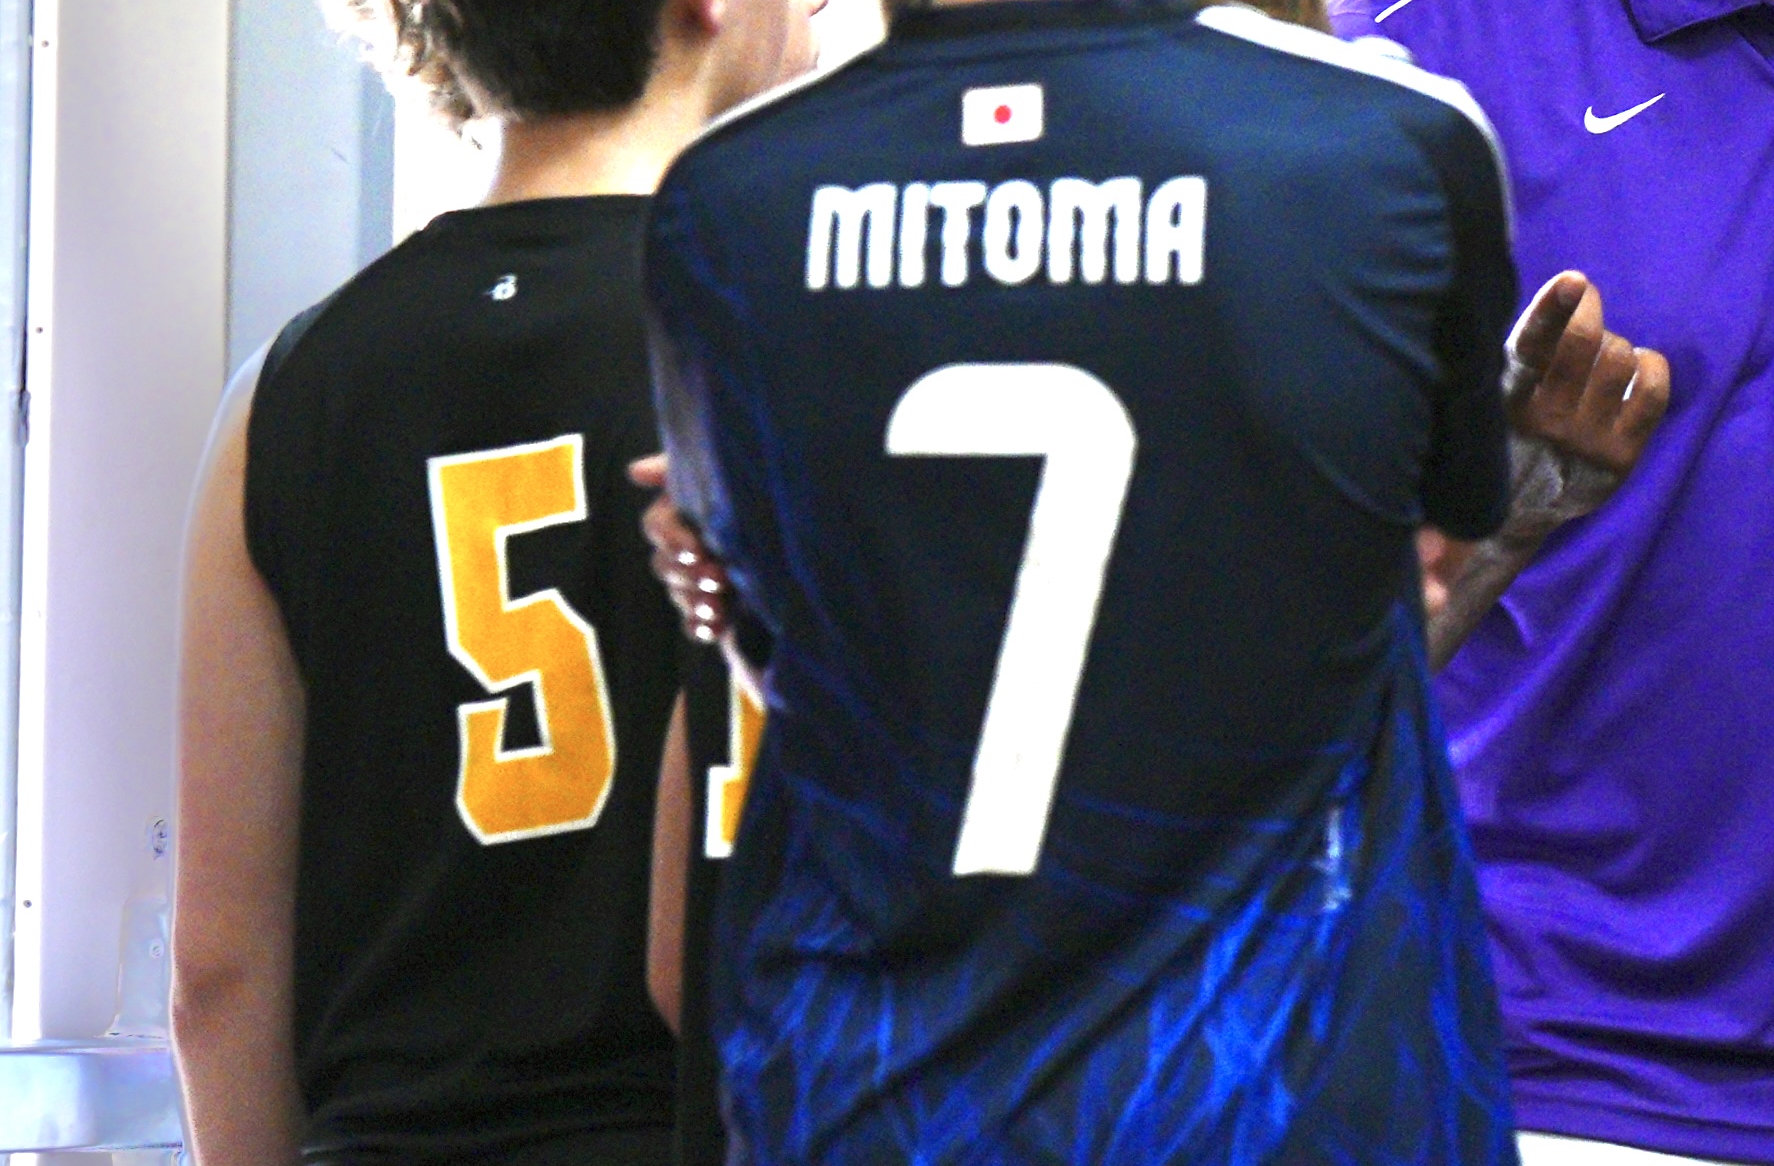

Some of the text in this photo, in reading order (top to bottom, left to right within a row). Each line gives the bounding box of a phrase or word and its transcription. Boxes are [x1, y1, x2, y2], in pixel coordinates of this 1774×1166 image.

[806, 174, 1207, 291] MITOMA
[427, 433, 616, 845] 5
[885, 362, 1138, 875] 7
